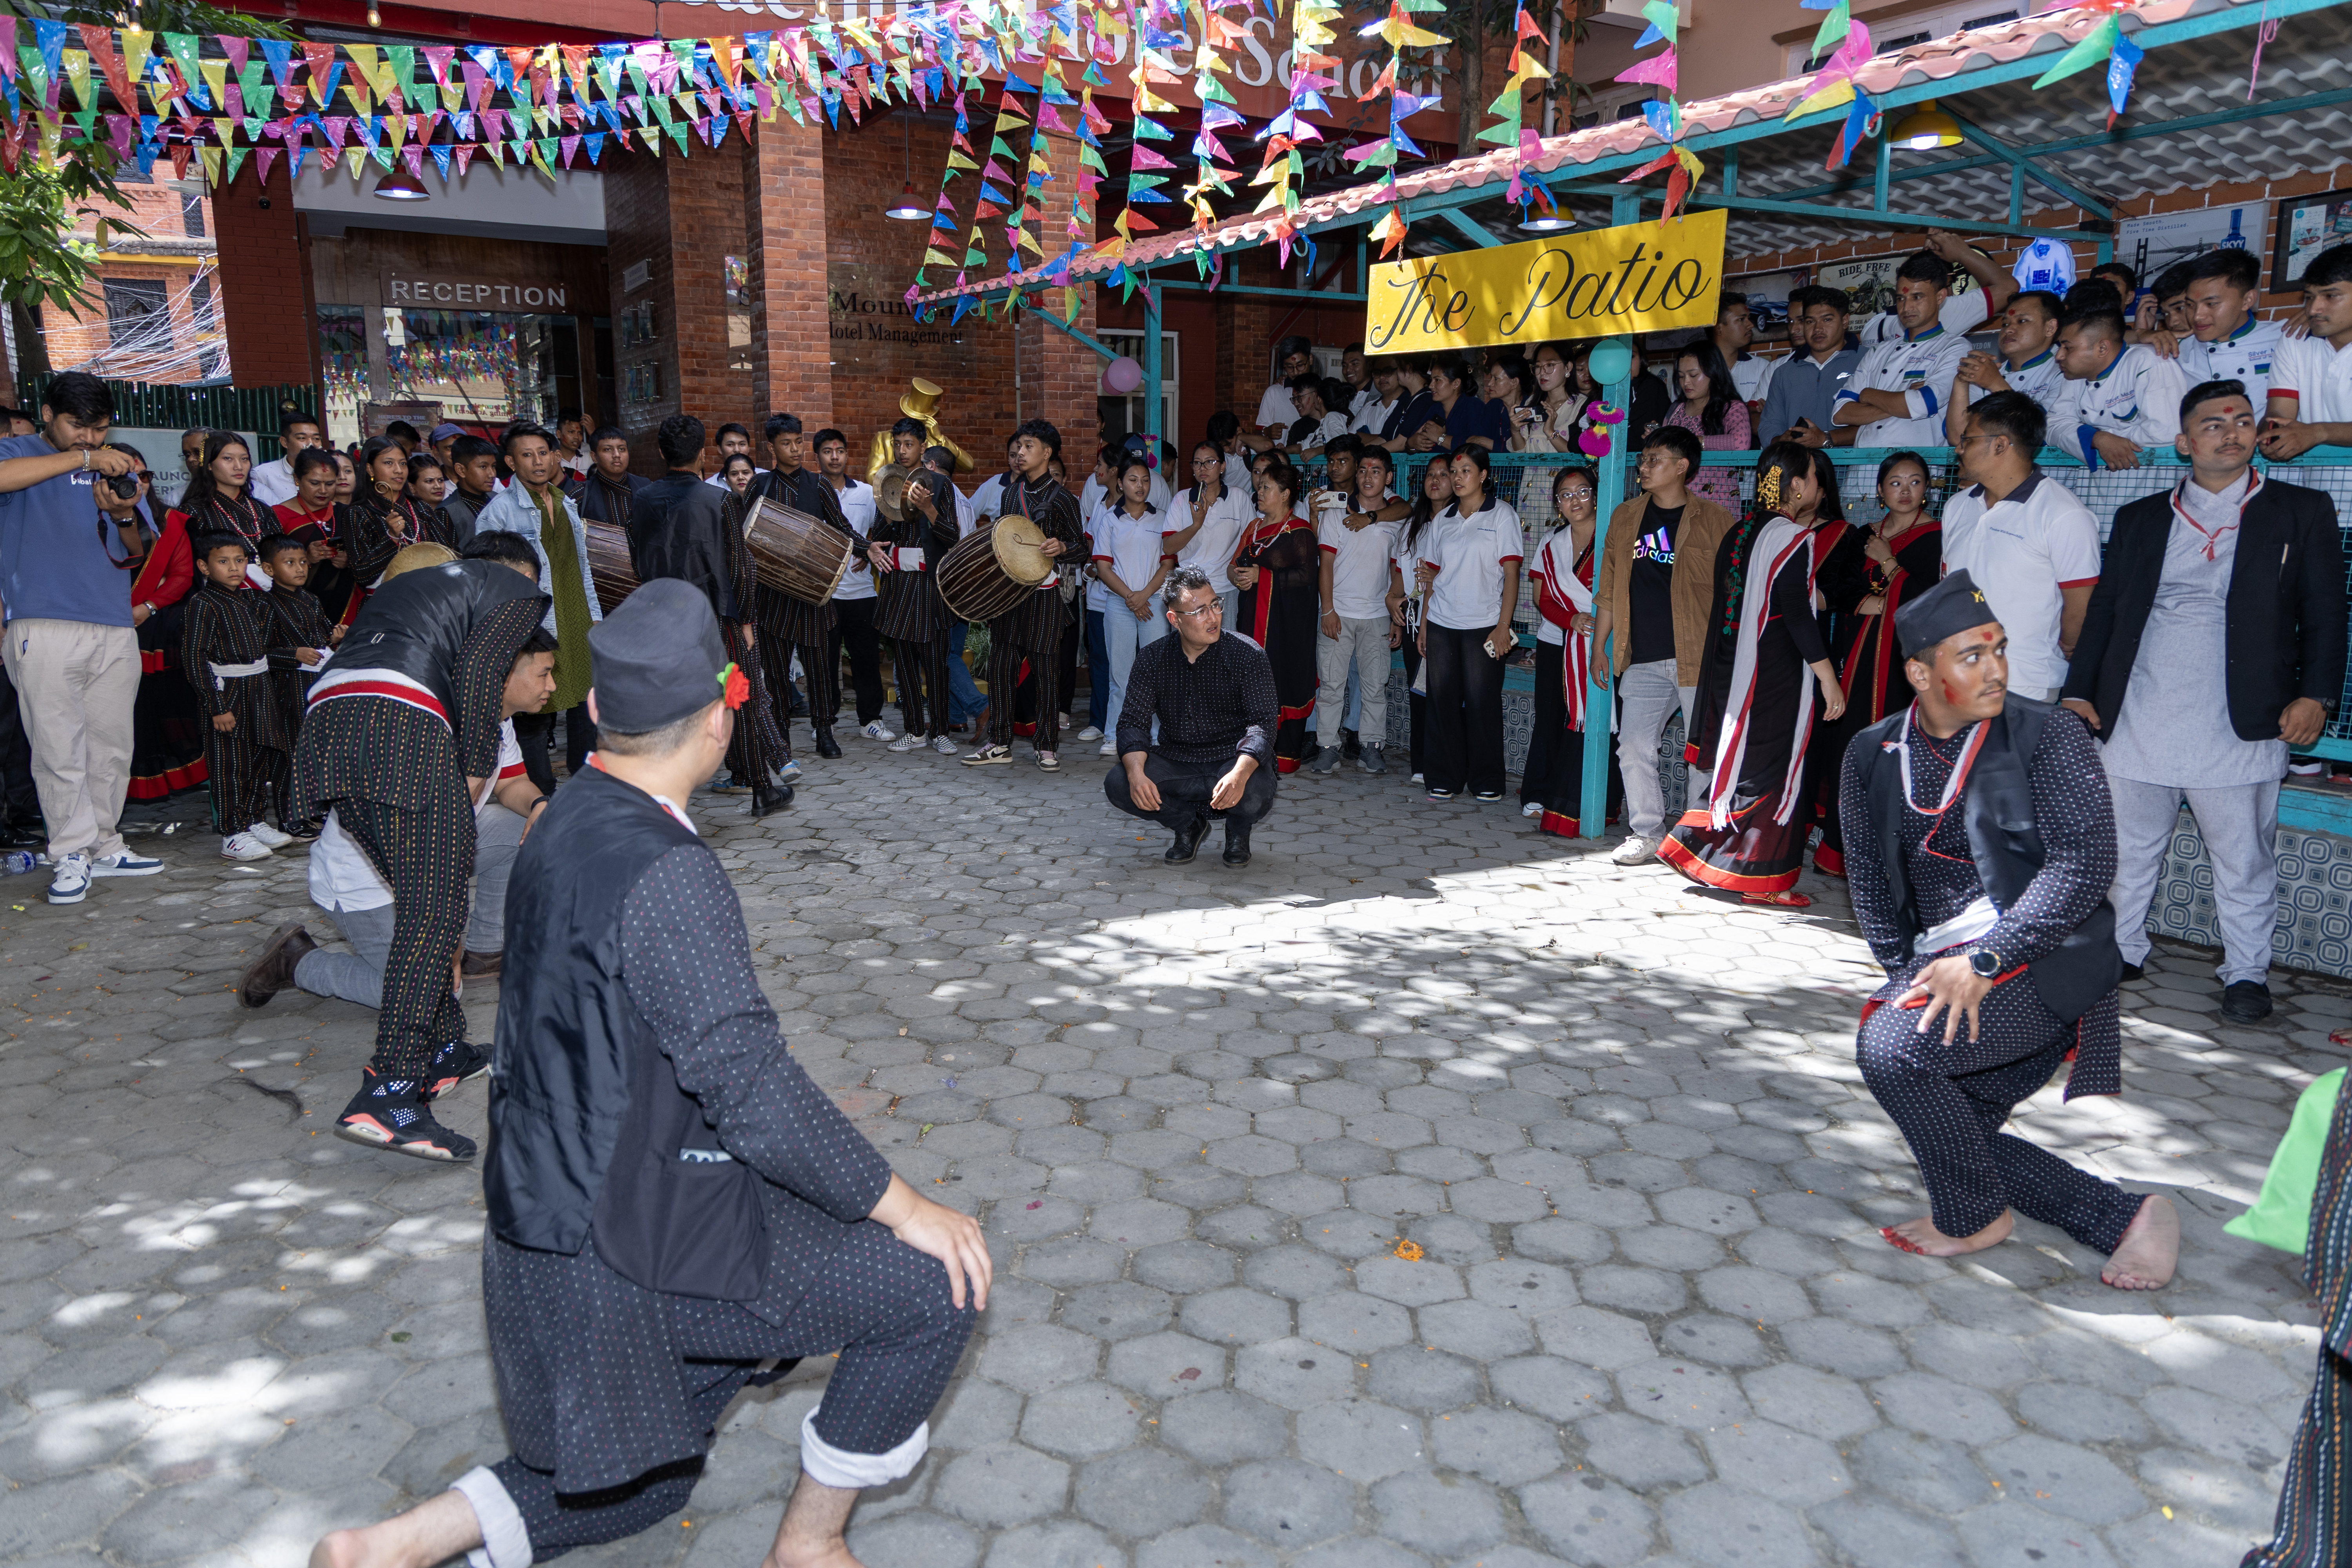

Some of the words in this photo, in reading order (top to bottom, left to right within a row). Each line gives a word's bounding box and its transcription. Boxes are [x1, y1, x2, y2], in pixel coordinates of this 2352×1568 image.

[2221, 240, 2245, 249] SKYY
[1838, 264, 1862, 278] RIDE
[1866, 262, 1891, 272] FREE
[391, 280, 565, 307] RECEPTION
[1371, 262, 1475, 348] The
[1499, 243, 1711, 336] Patio
[868, 322, 963, 348] Management
